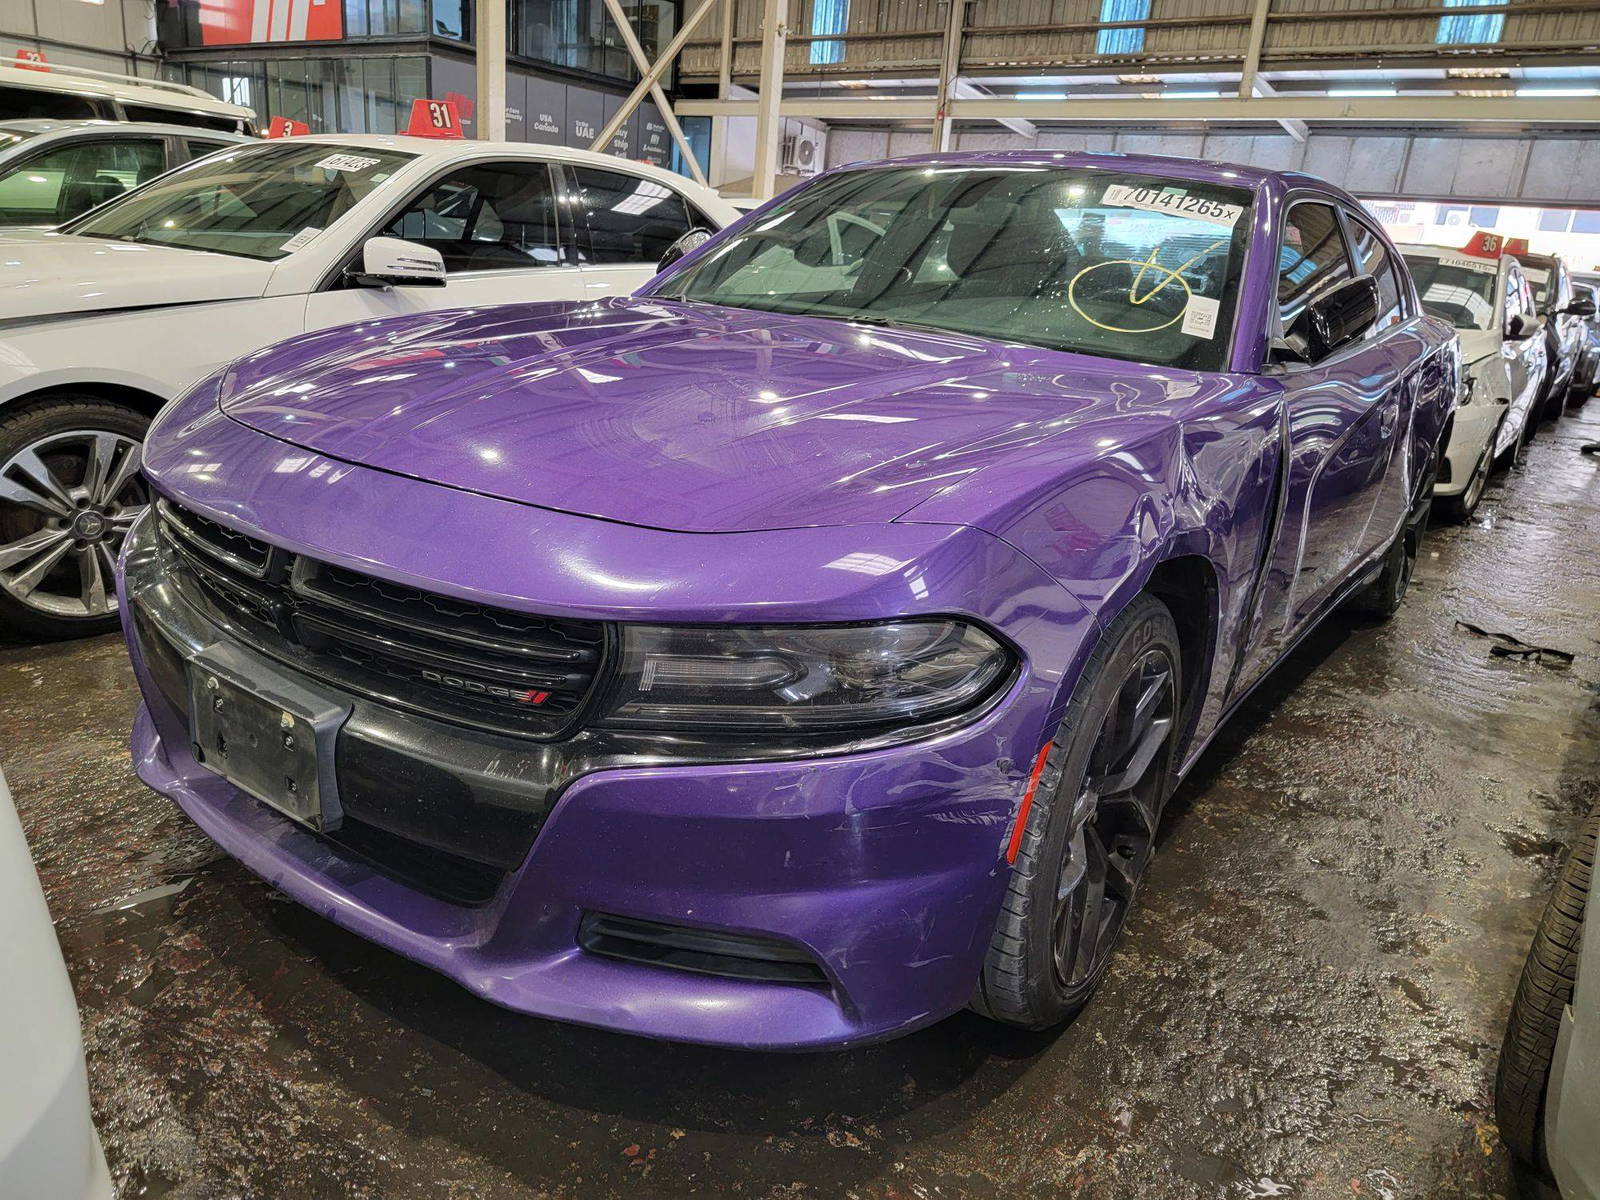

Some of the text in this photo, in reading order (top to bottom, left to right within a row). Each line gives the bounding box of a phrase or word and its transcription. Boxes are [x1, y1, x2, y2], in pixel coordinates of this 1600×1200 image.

[430, 103, 451, 127] 31
[539, 114, 552, 122] USA
[534, 122, 559, 133] Canada
[576, 126, 594, 139] UAE
[1483, 236, 1497, 252] 36
[422, 670, 533, 703] DODGE
